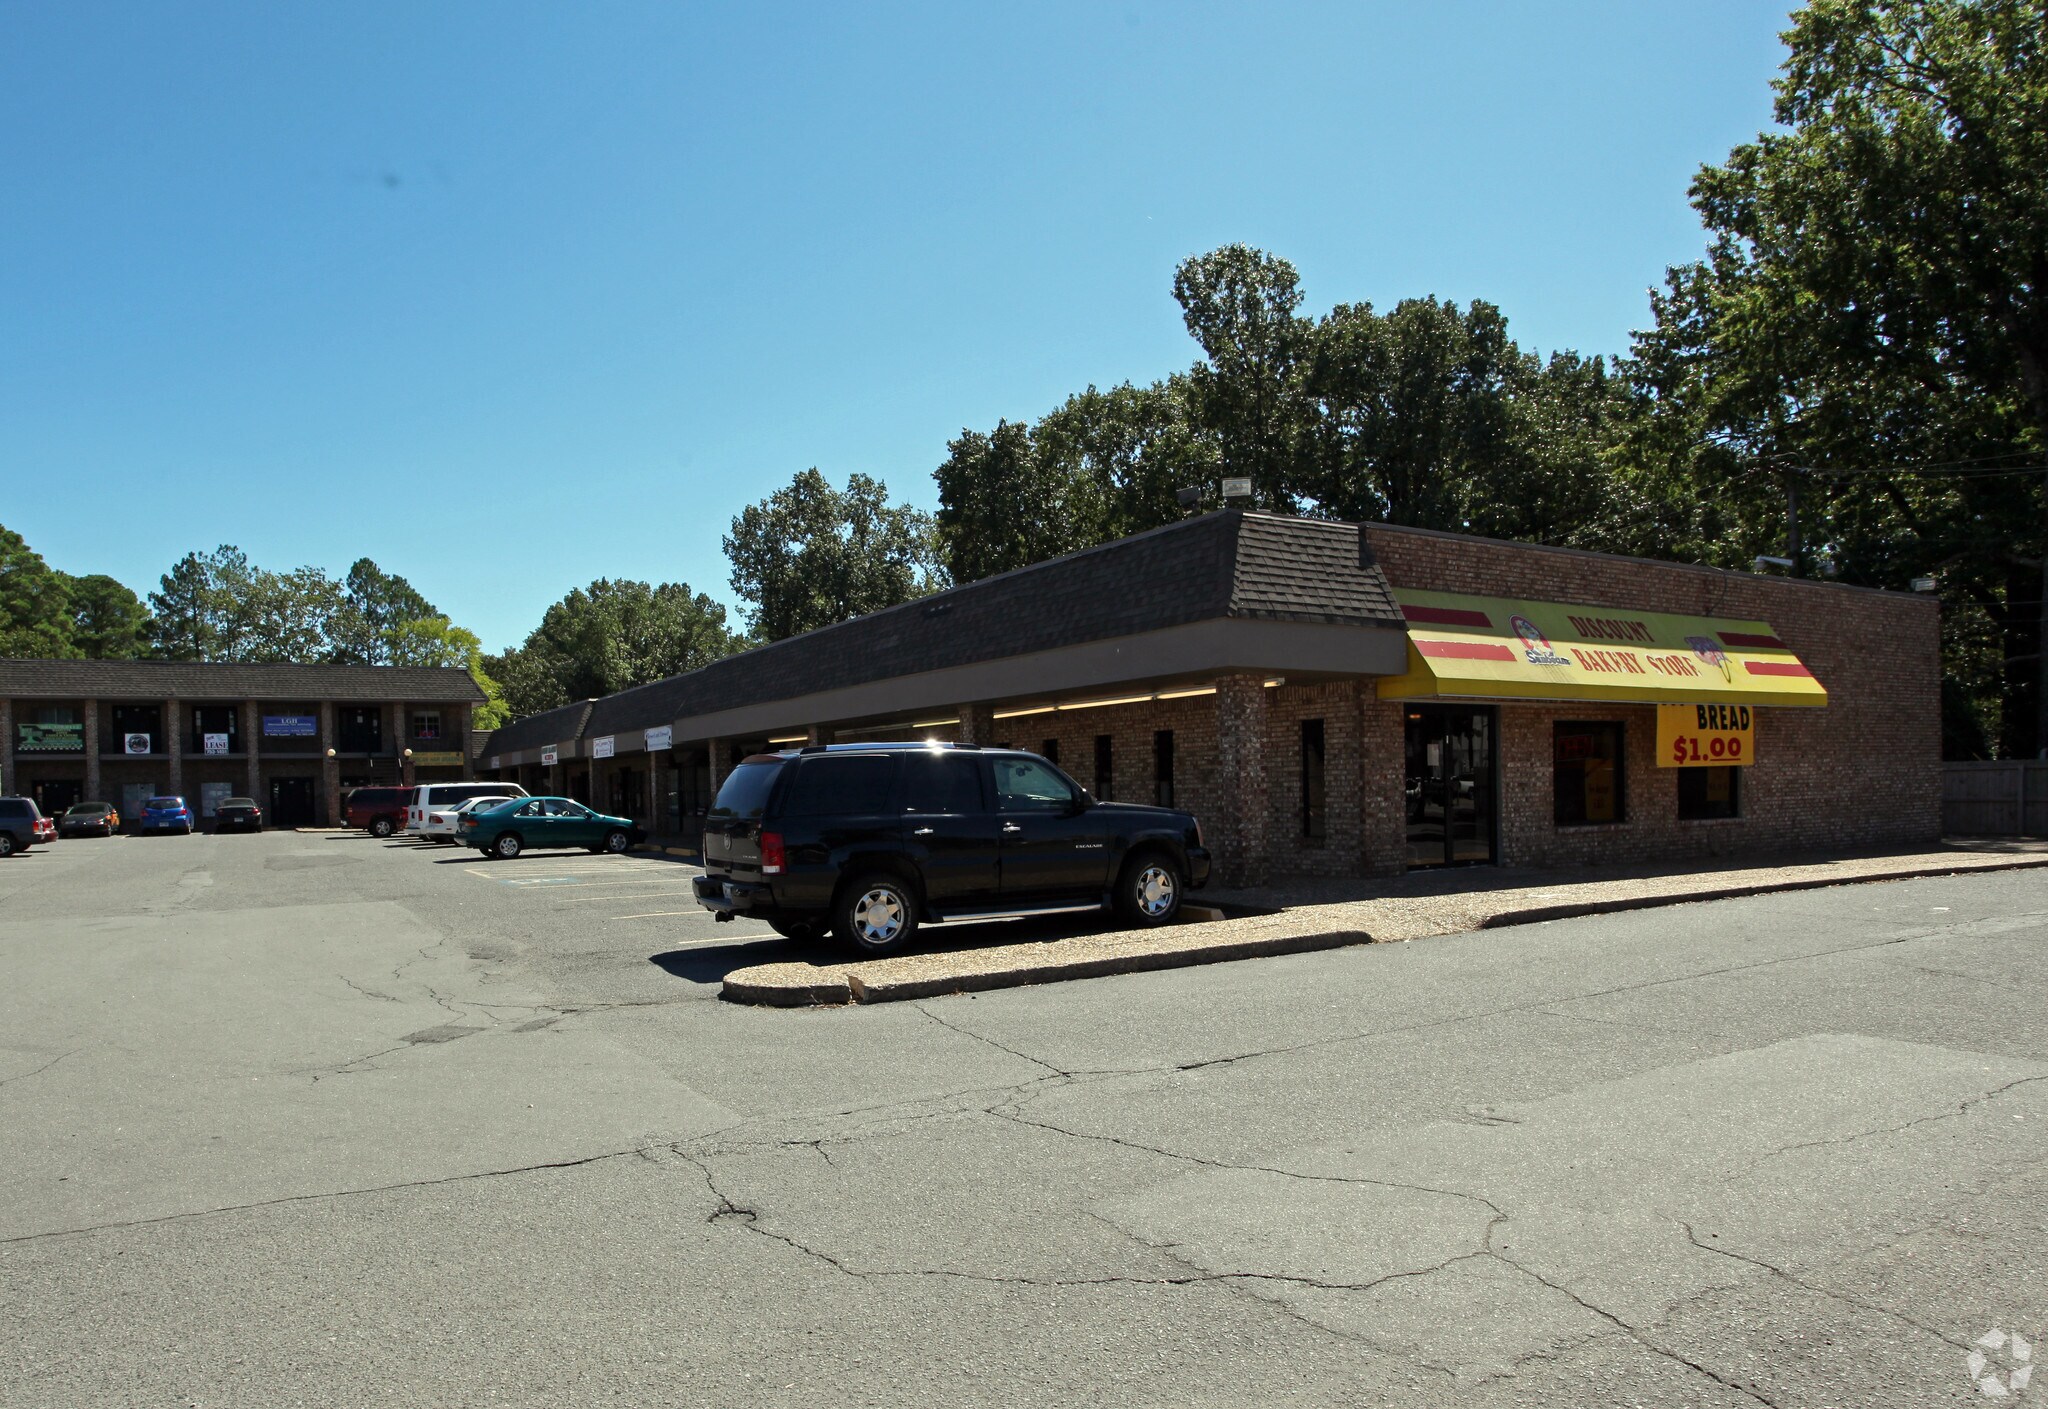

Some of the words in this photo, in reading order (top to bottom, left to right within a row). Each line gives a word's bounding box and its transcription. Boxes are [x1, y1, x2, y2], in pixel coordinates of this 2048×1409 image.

[1567, 615, 1655, 642] DISCOUNT
[1570, 648, 1646, 674] BAKERY
[1646, 654, 1700, 677] STORE
[1697, 704, 1750, 731] BREAD
[1673, 736, 1742, 765] $1.00
